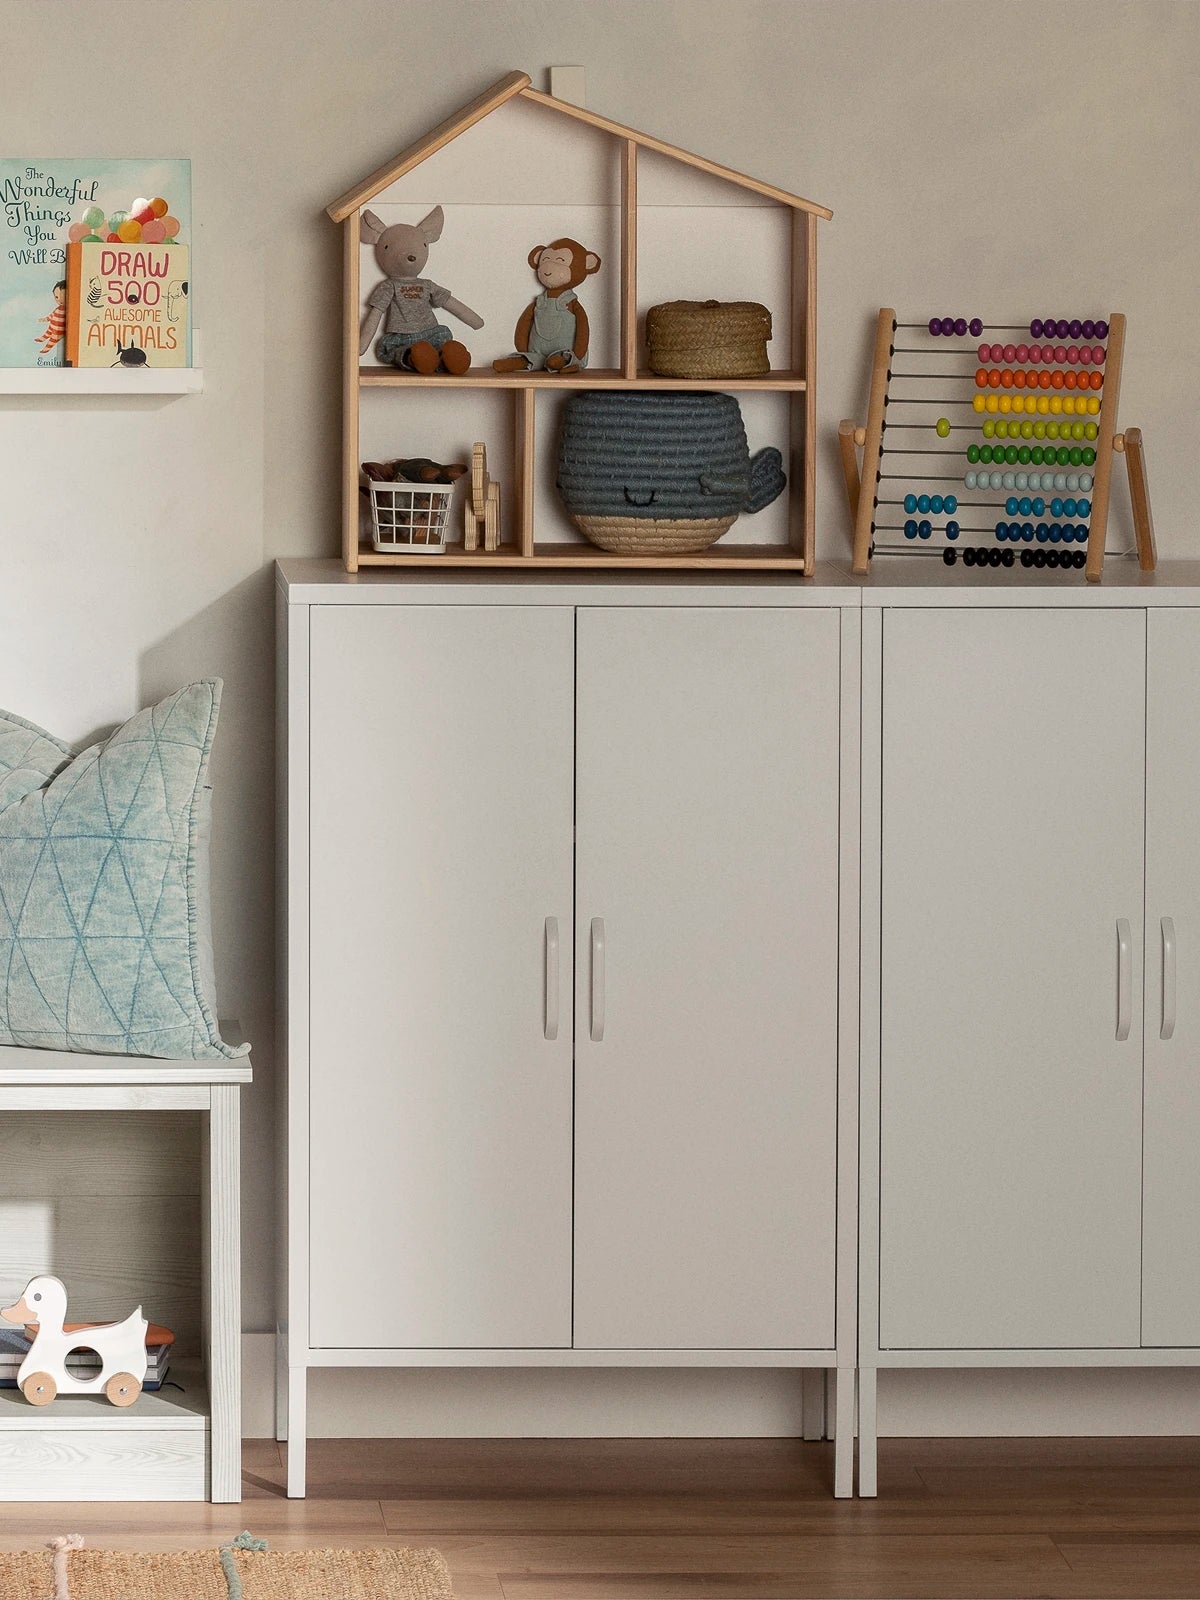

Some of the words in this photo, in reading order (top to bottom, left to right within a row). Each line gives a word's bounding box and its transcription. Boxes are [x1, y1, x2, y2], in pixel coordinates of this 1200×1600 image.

[25, 167, 44, 180] The
[4, 200, 71, 228] Things
[23, 224, 57, 247] You
[8, 248, 48, 266] Will
[49, 248, 67, 264] B
[100, 250, 170, 279] DRAW
[107, 280, 162, 306] 500
[400, 285, 424, 293] SUPER
[104, 308, 162, 323] AWESOME
[87, 322, 178, 350] ANIMALS
